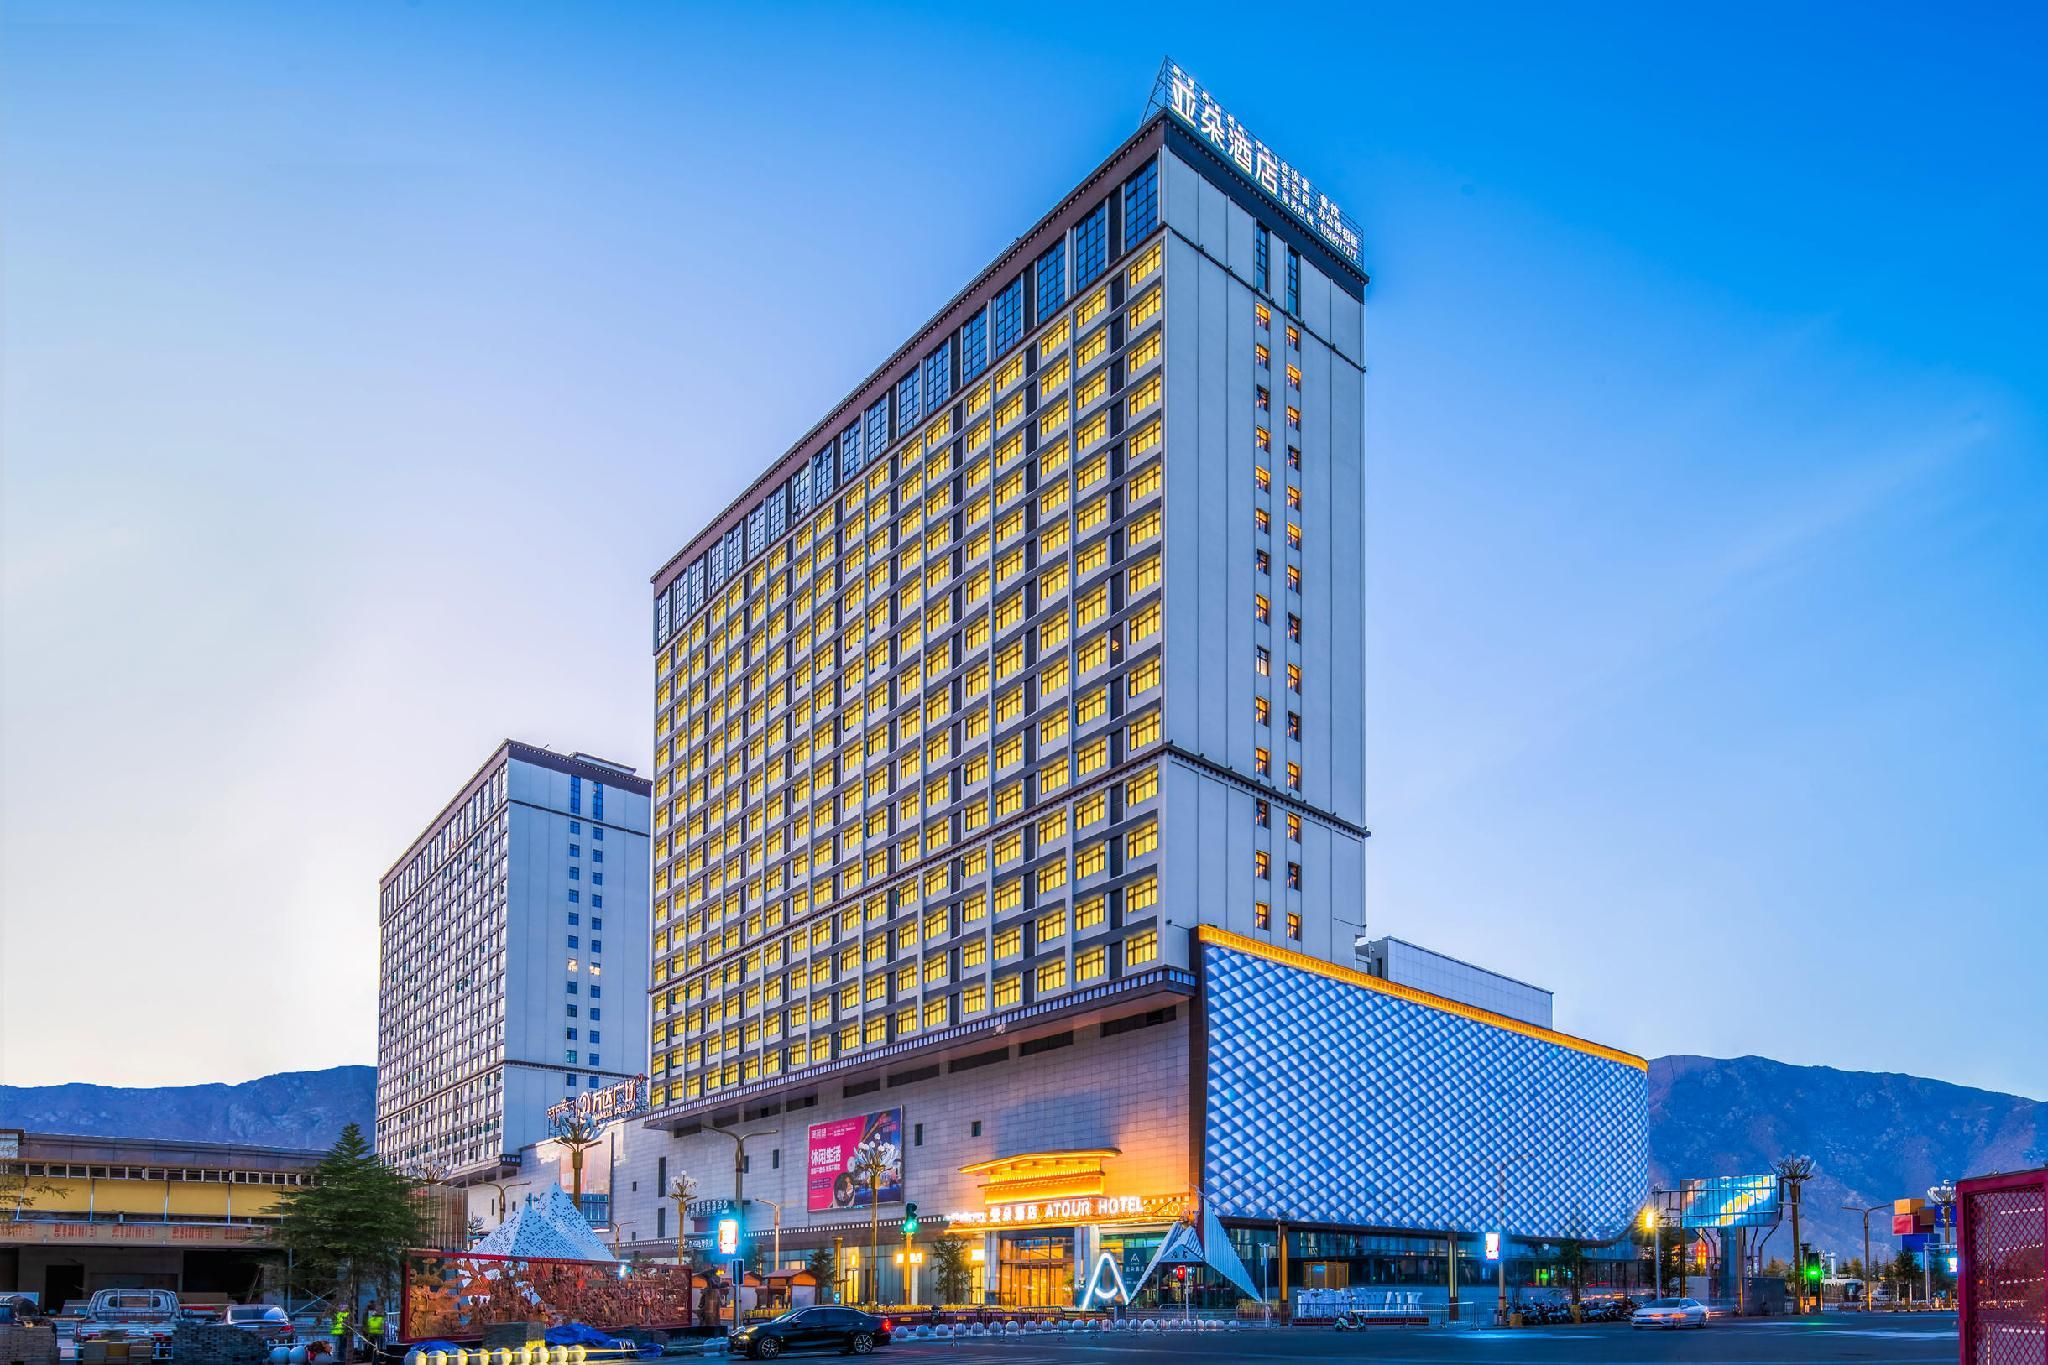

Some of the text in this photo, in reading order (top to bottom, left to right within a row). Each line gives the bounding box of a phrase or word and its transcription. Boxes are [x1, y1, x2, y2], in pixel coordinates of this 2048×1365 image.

[1172, 77, 1278, 195] 亚朵酒店
[1045, 1199, 1090, 1218] ATOUR
[1099, 1196, 1145, 1214] HOTEL
